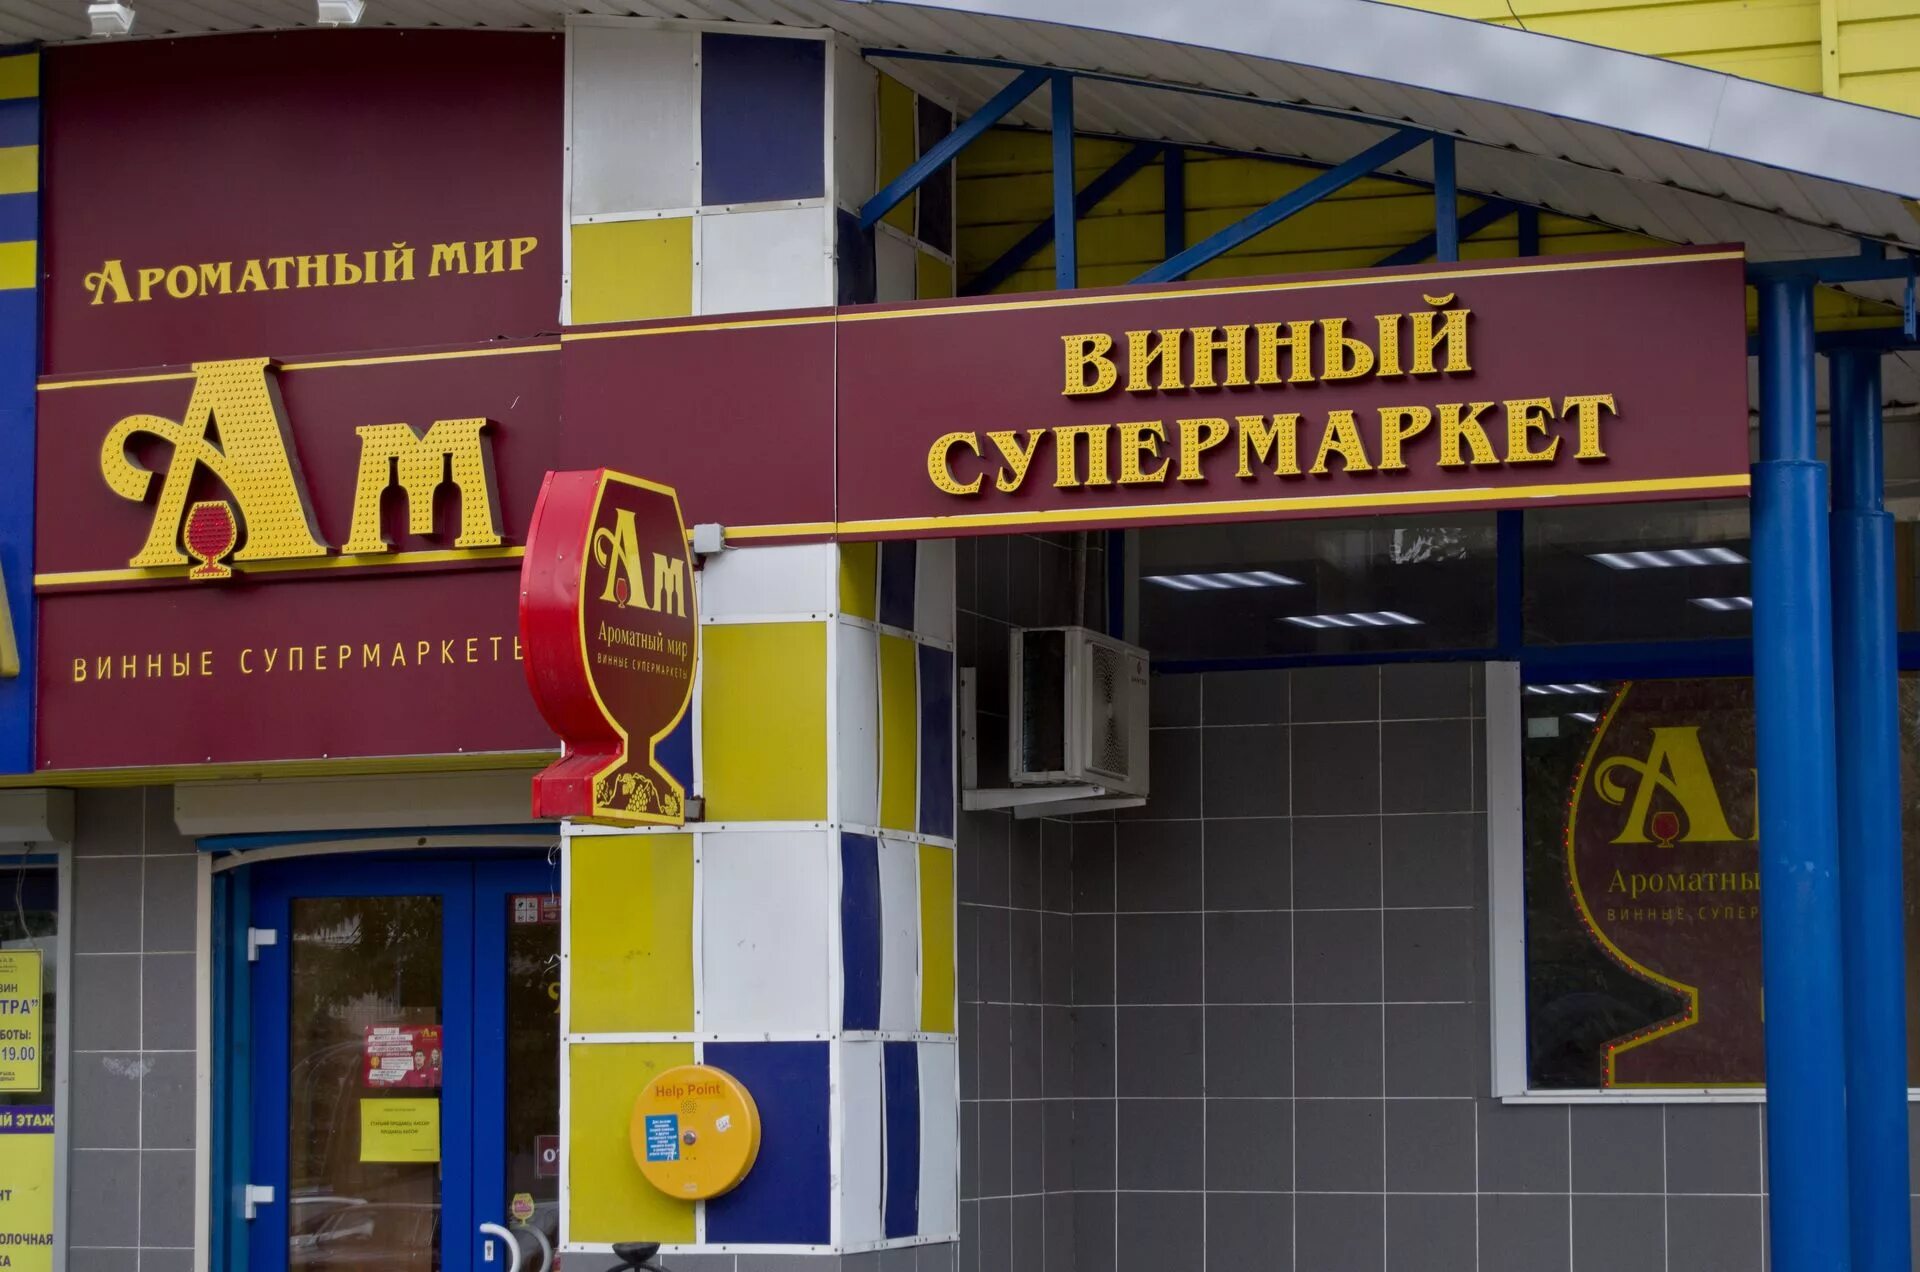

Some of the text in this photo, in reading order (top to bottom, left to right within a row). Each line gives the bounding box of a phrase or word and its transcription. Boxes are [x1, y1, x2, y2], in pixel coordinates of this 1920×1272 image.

[1061, 292, 1472, 396] ВИННЫЙ
[927, 393, 1620, 495] СУПЕРМАРКЕТ
[598, 620, 688, 662] Ароматный мир
[74, 651, 213, 682] ВИННЫЕ
[597, 652, 688, 680] ВИННЫЕ СУПЕРМАРКЕТЫ
[2, 1046, 35, 1061] 19.00
[656, 1083, 721, 1098] Help Point
[16, 1113, 54, 1127] ЭТАЖ
[0, 1233, 53, 1246] ОЛОЧНАЯ
